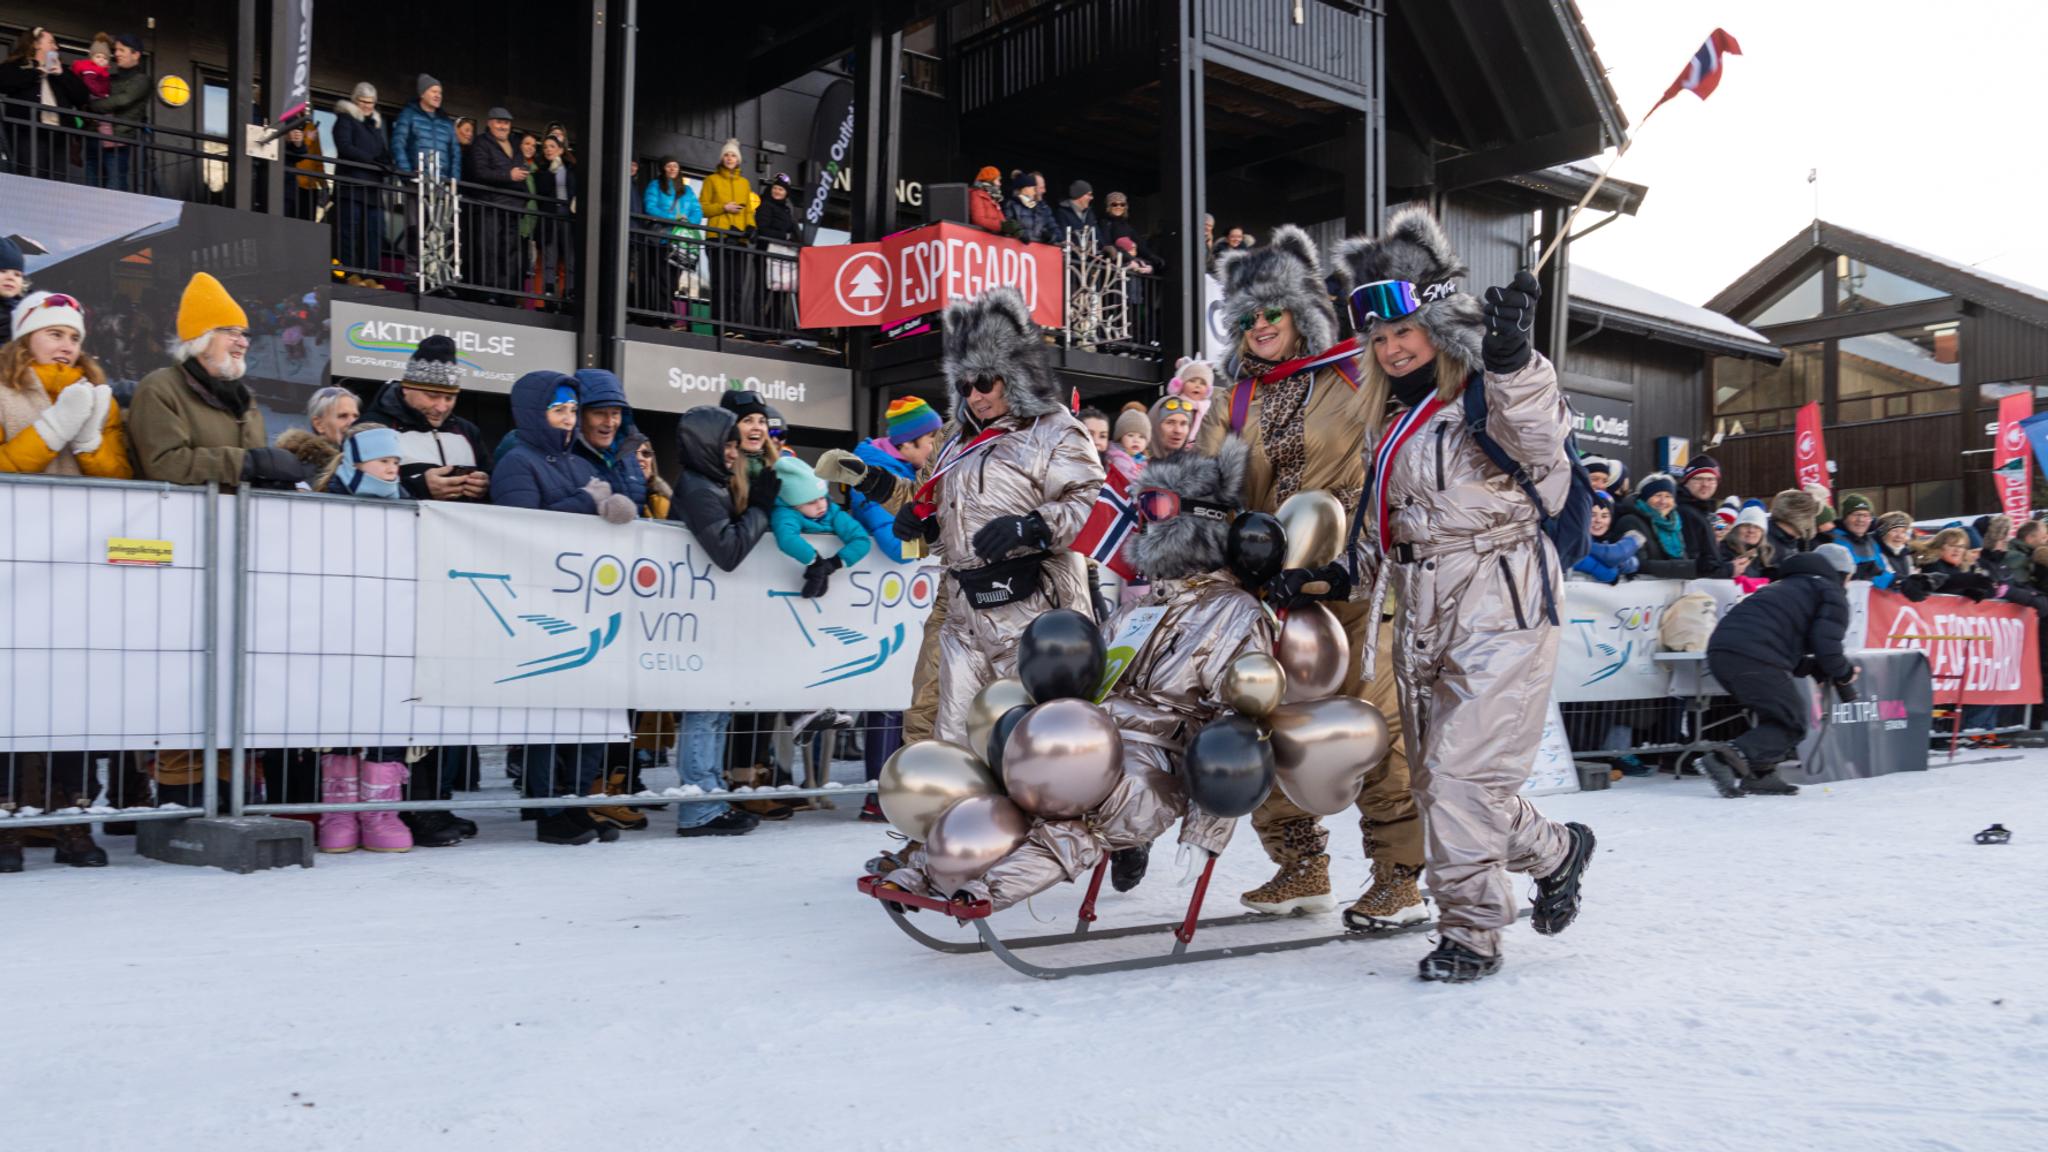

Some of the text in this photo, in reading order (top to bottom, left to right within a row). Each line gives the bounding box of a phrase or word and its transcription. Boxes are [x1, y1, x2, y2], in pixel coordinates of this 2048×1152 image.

[806, 170, 834, 224] Sport
[900, 238, 1038, 312] ESPEGARD
[361, 320, 516, 357] AKTIV HELSE
[668, 367, 807, 402] Sport Outlet
[552, 544, 716, 614] spark
[975, 589, 1009, 604] PUMA
[639, 611, 698, 642] vm
[639, 652, 703, 672] GEILO
[1931, 614, 2025, 692] ESPEGARD
